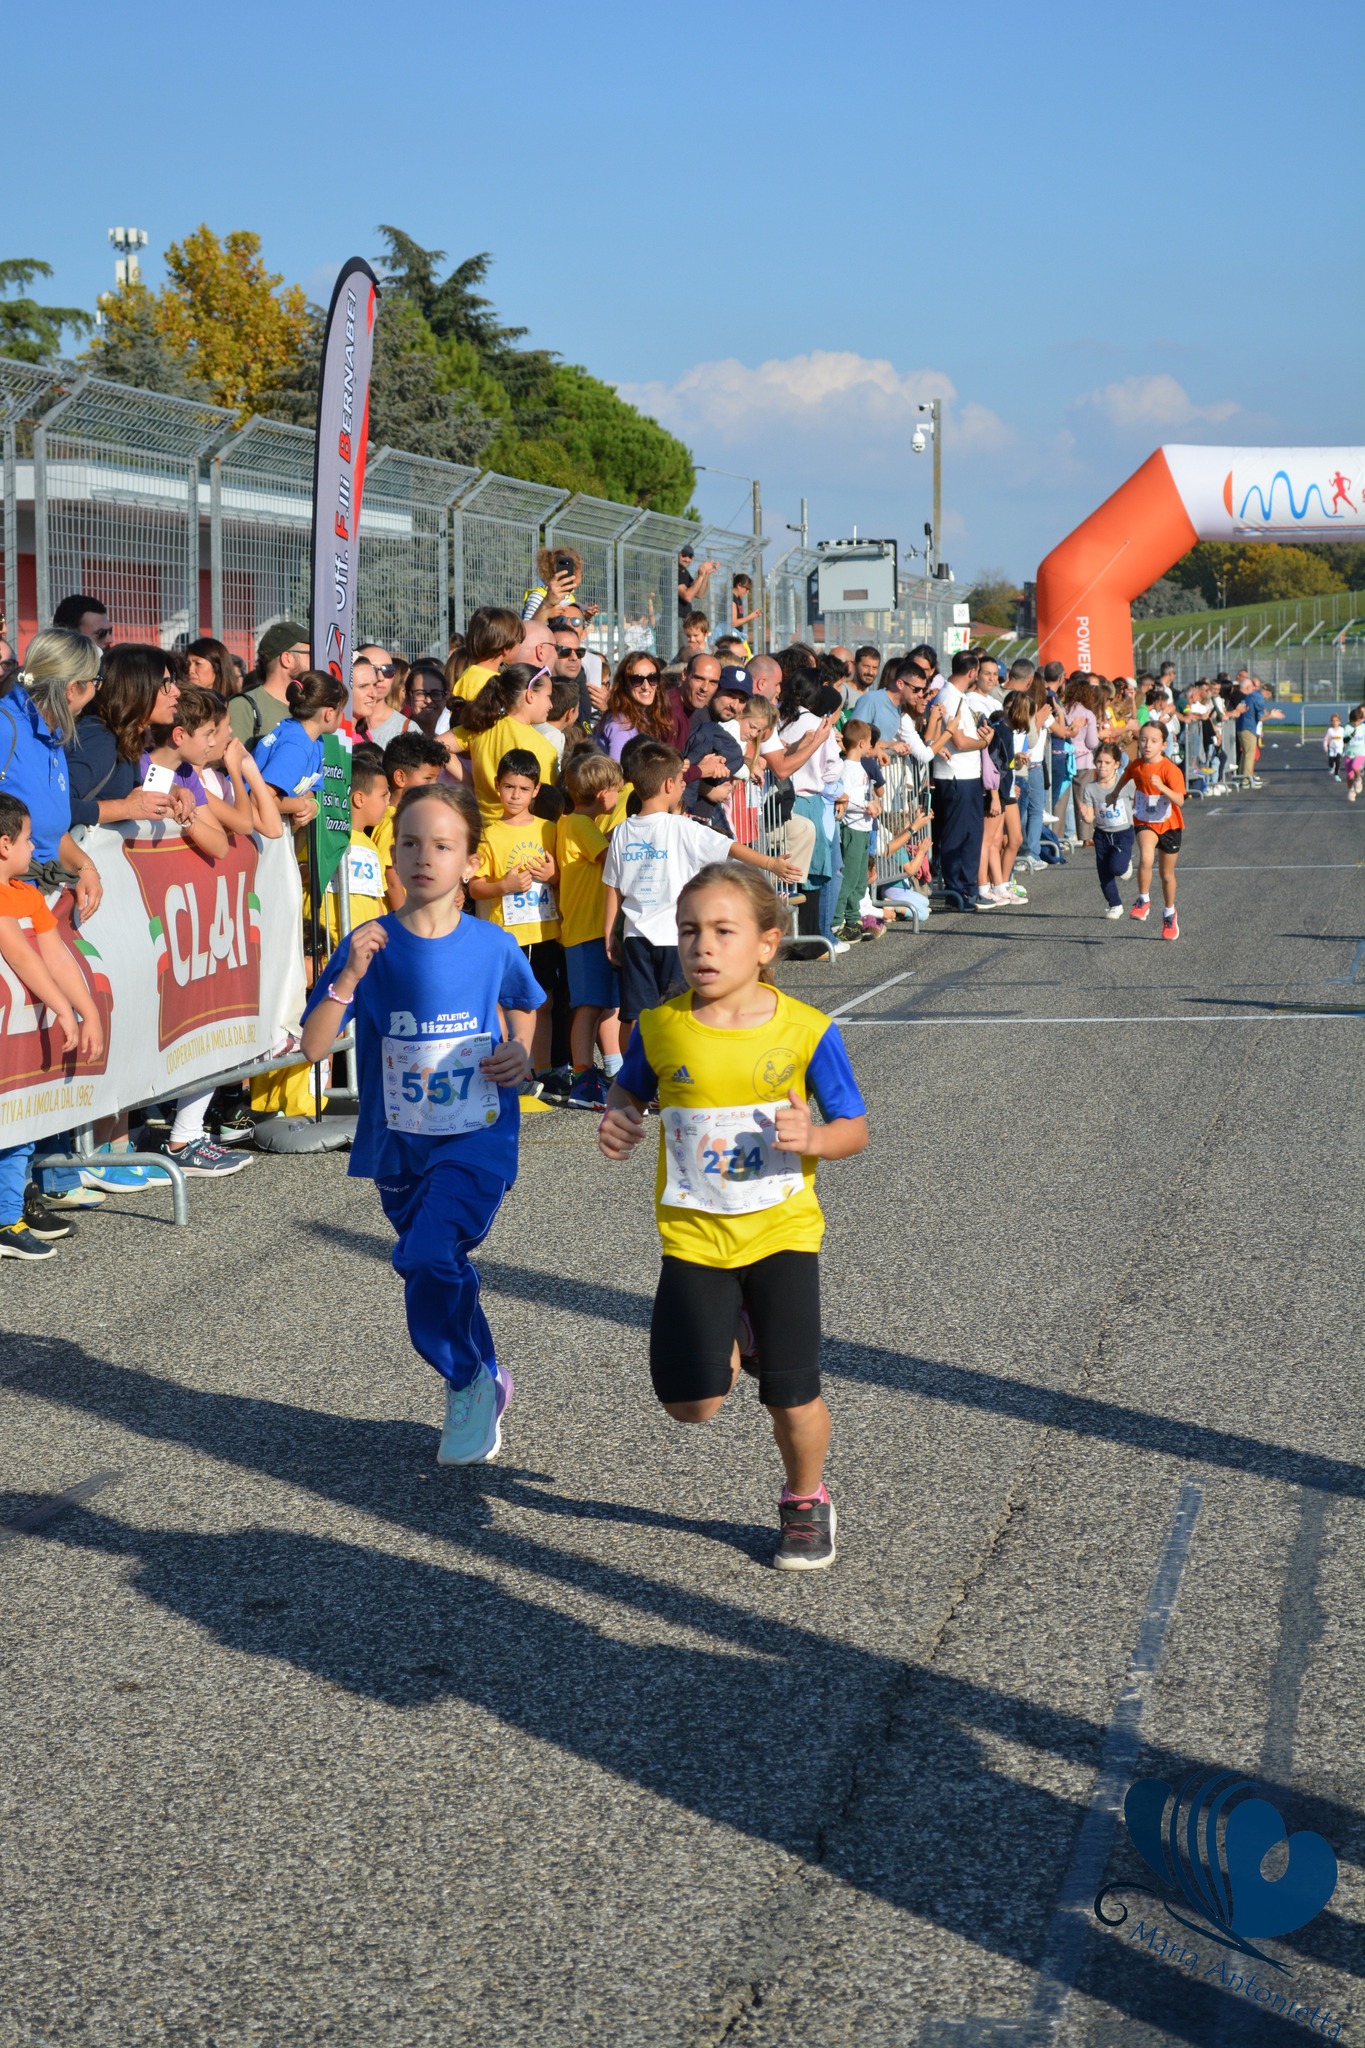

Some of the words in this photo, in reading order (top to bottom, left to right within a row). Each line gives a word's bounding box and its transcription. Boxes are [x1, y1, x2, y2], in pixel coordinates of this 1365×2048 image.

[339, 288, 357, 464] BERNABEI
[1076, 616, 1092, 674] POWER
[622, 851, 643, 862] TOUR
[644, 849, 669, 860] TRACK
[514, 889, 550, 908] 594
[165, 871, 248, 987] CLAI
[437, 1011, 470, 1022] ATLETICA
[166, 1034, 206, 1075] COOPERATIVA
[205, 1032, 211, 1053] A
[211, 1027, 234, 1051] IMOLA
[233, 1024, 248, 1045] DAL
[1, 1097, 23, 1126] TIVA
[25, 1095, 31, 1119] A
[33, 1088, 60, 1116] IMOLA
[61, 1085, 75, 1110] DAL
[76, 1084, 95, 1108] 1962
[402, 1066, 475, 1105] 557
